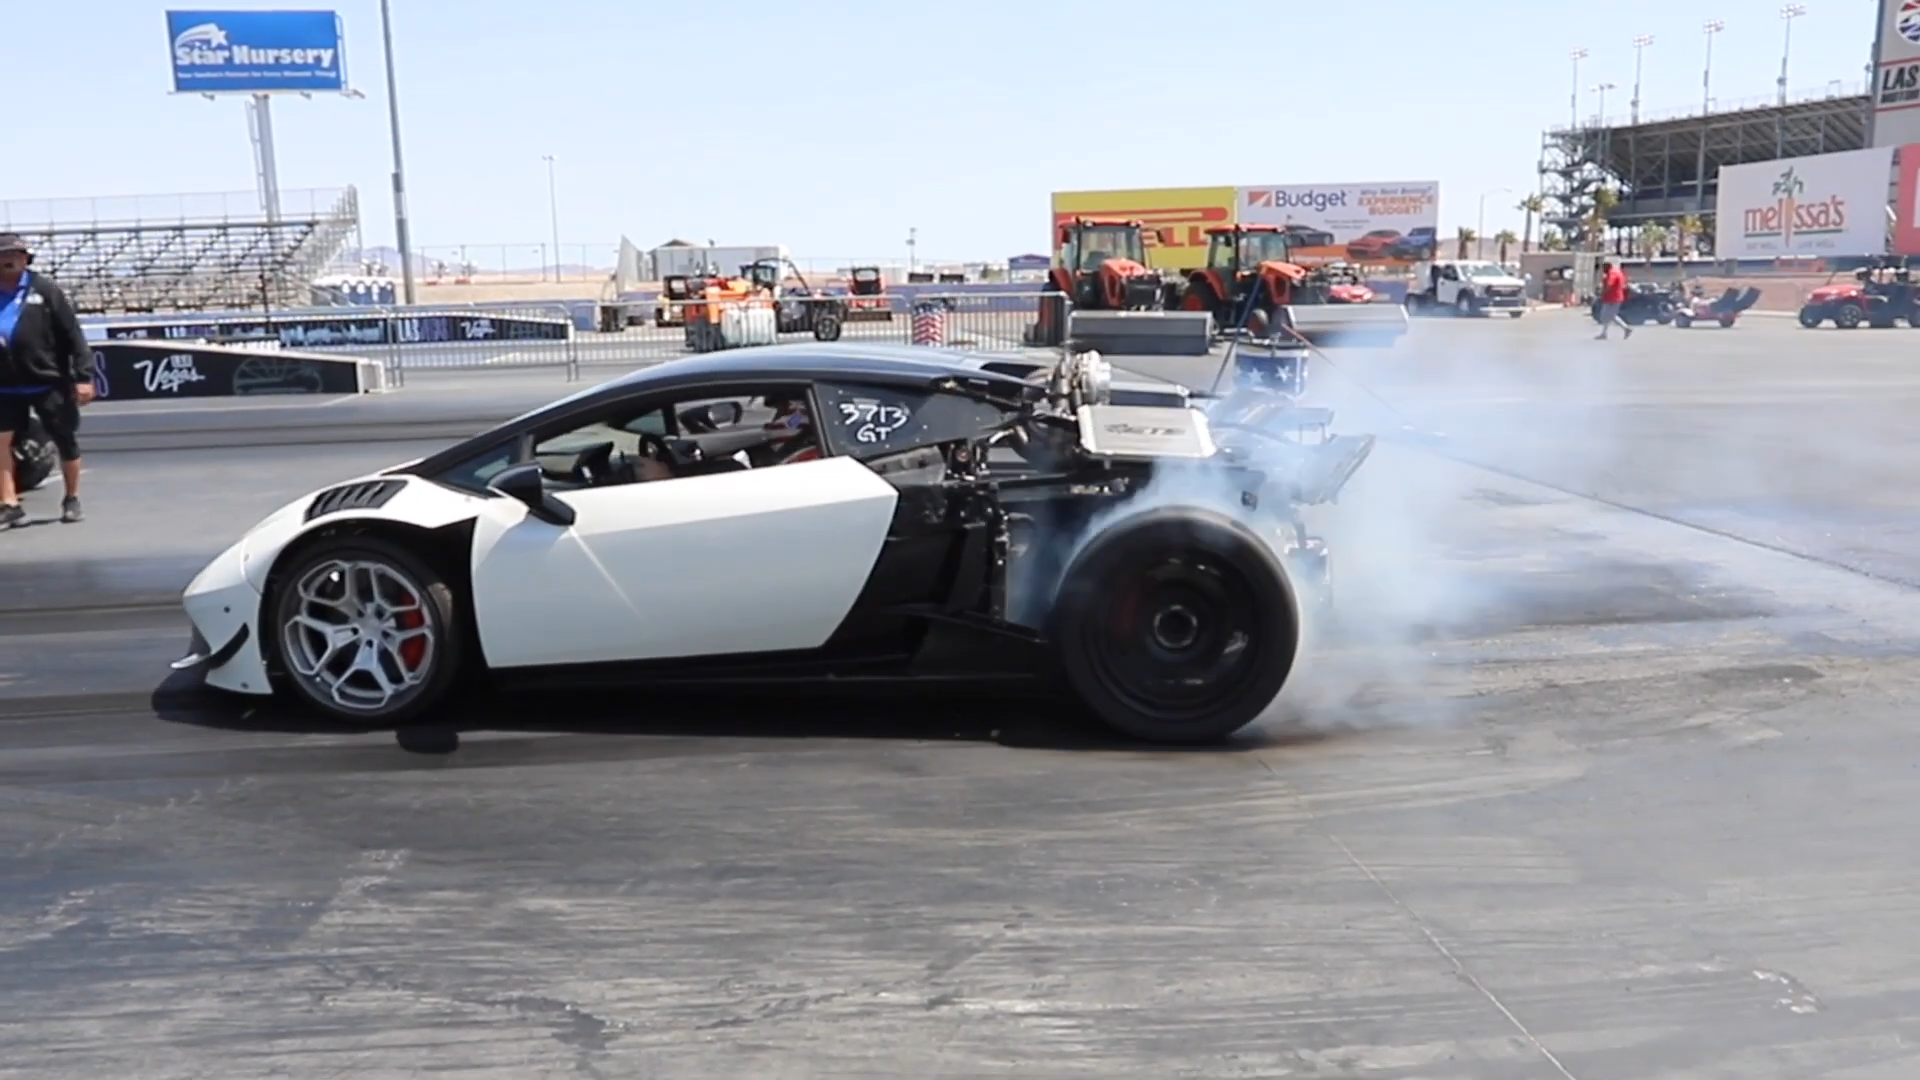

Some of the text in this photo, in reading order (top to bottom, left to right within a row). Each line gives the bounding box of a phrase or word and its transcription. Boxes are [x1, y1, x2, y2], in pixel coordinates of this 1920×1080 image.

[176, 45, 335, 68] Star Nursery
[1882, 64, 1919, 91] LAS
[1275, 190, 1348, 212] Budget
[1358, 194, 1434, 207] EXPERIENCE
[133, 357, 206, 393] Vegas
[839, 403, 908, 429] 3713
[857, 423, 893, 443] GT
